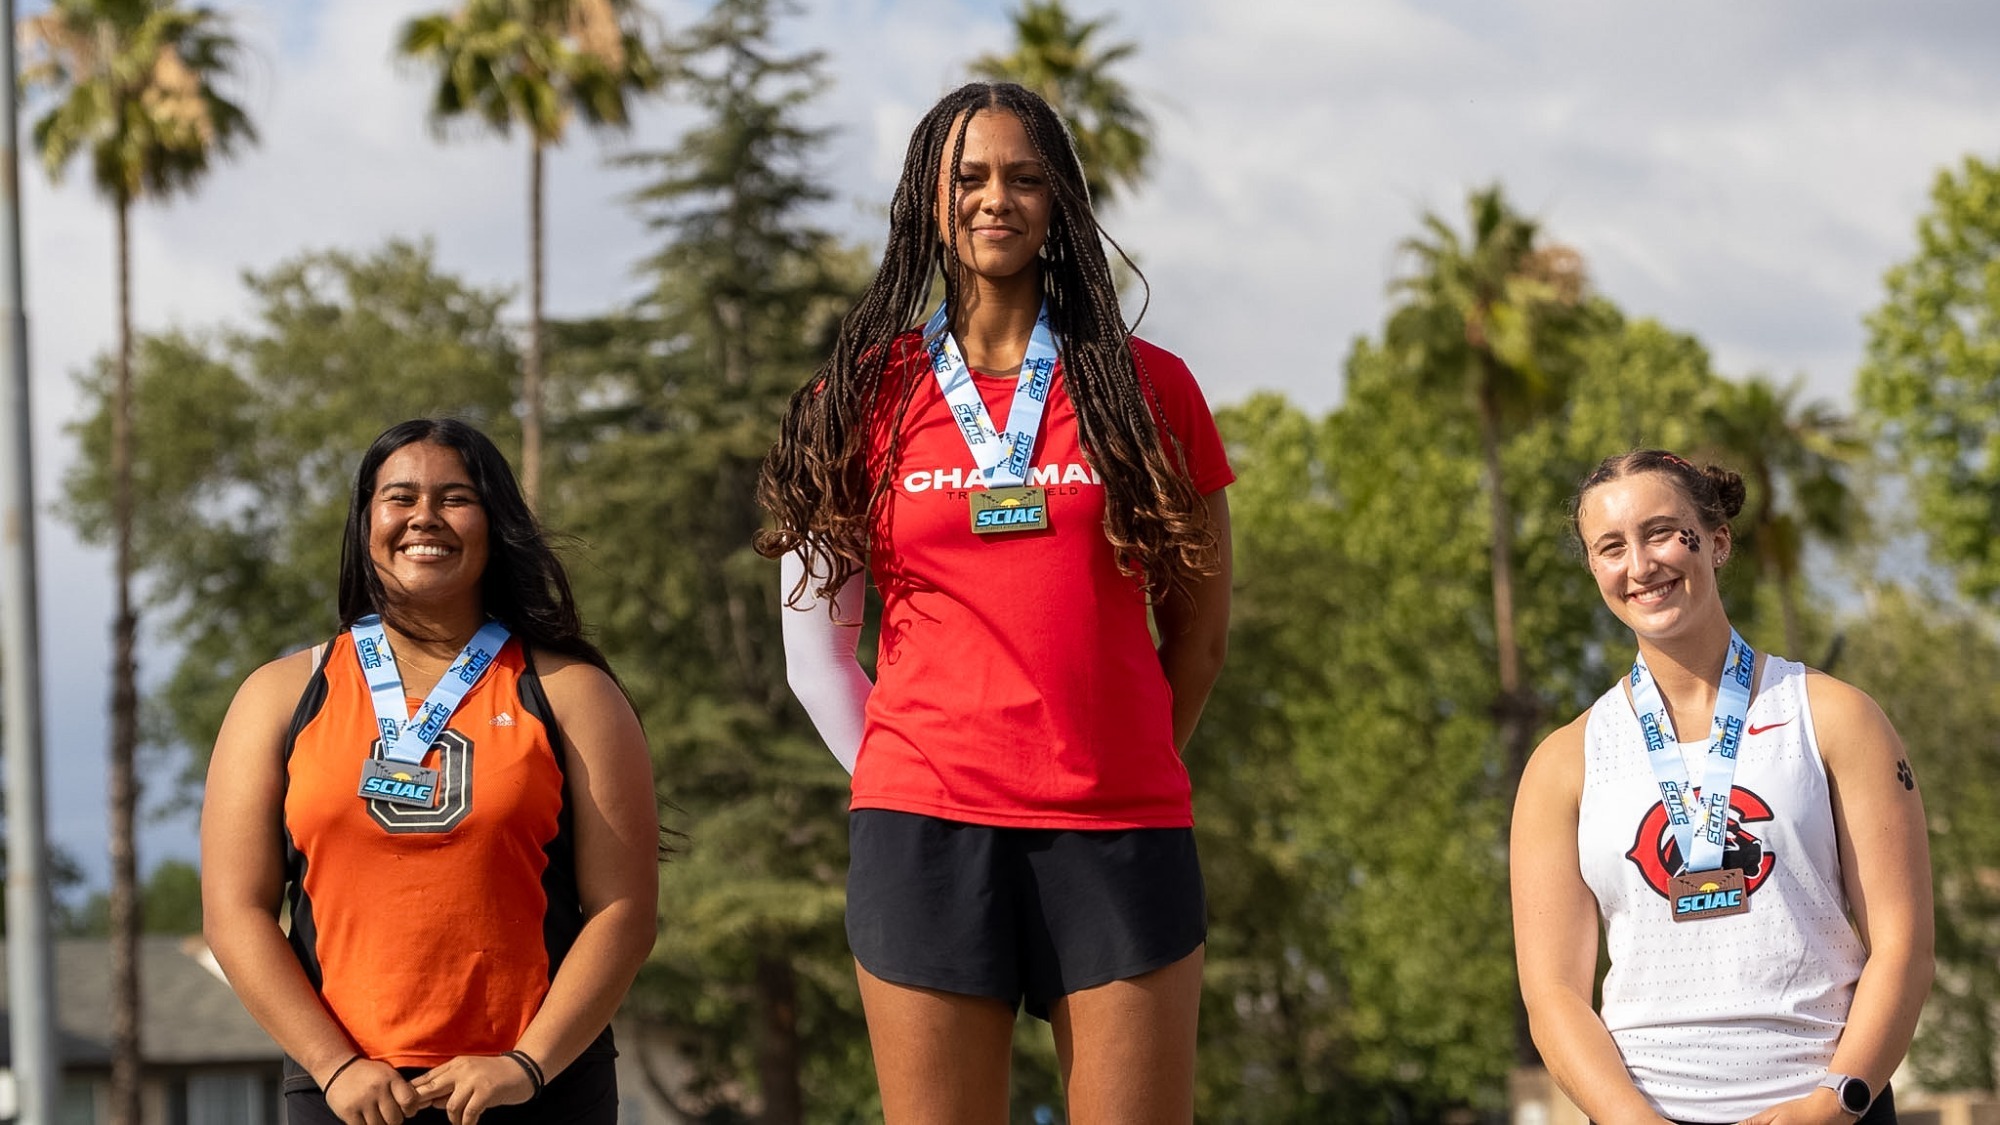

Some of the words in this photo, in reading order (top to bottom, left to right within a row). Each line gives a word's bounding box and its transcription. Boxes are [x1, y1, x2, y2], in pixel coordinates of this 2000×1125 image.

[1030, 358, 1049, 401] SCIAC
[956, 404, 985, 444] SCIAC
[1010, 432, 1031, 476] SCIAC
[904, 464, 1101, 493] CHAMA
[975, 505, 1043, 527] SCIAC
[359, 638, 381, 669] SCIAC
[460, 649, 489, 683] SCIAC
[1736, 644, 1752, 688] SCIAC
[419, 703, 448, 743] SCIAC
[1642, 713, 1664, 751] SCIAC
[1721, 715, 1742, 758] SCIAC
[362, 776, 434, 802] SCIAC
[1662, 781, 1689, 825] SCIAC
[1707, 794, 1725, 845] SCIAC
[1675, 888, 1743, 915] SCIAC
